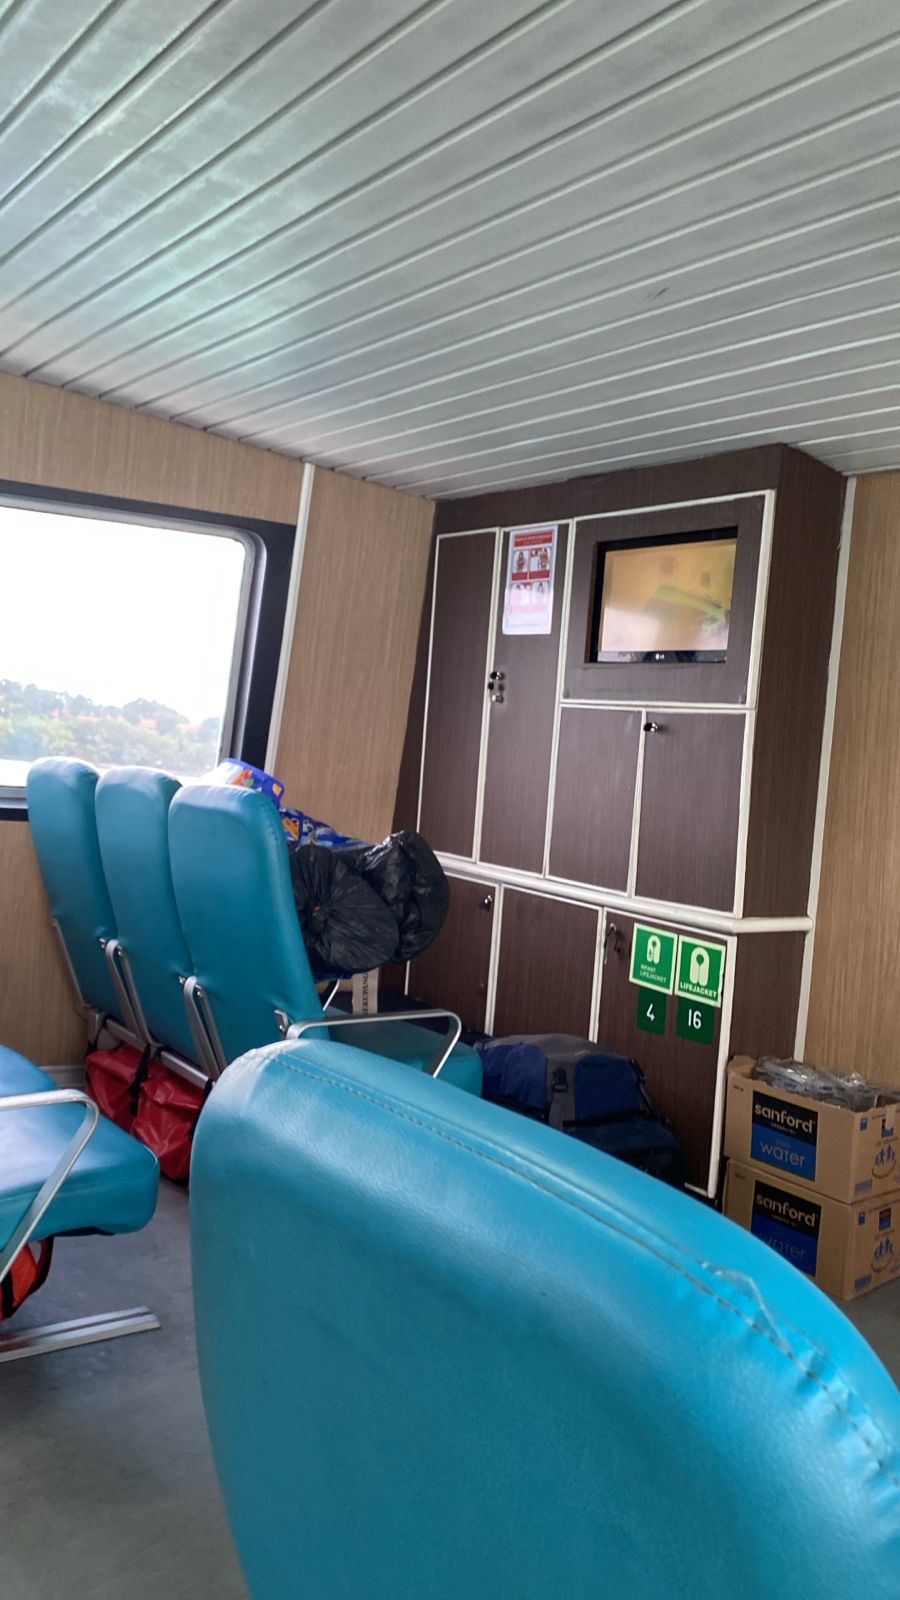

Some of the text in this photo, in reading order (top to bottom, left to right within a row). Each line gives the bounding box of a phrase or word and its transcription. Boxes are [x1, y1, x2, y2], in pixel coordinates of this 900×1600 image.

[639, 970, 667, 983] LIFEJACKET
[640, 964, 656, 973] INFANT
[680, 981, 717, 999] LIFEJACKET
[646, 1003, 655, 1021] 4
[688, 1008, 702, 1029] 16
[755, 1104, 813, 1134] sanford
[760, 1139, 806, 1168] water
[756, 1194, 816, 1227] sanford
